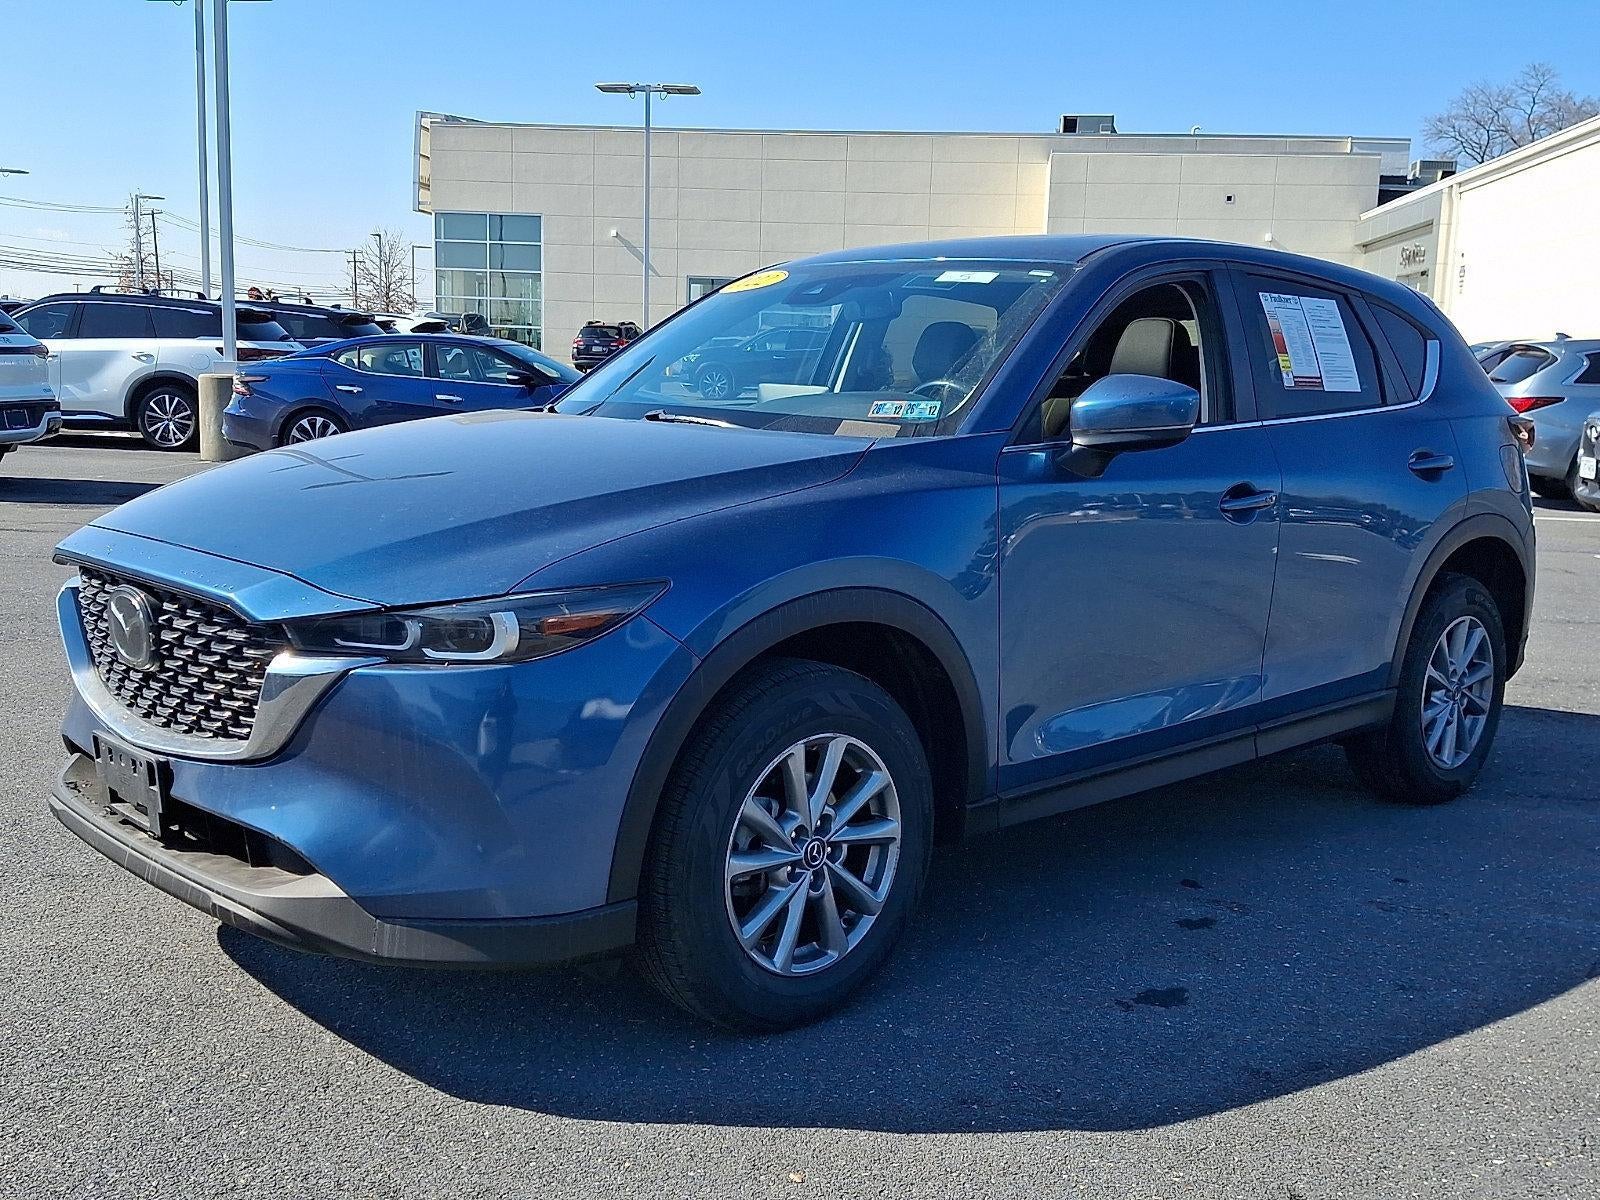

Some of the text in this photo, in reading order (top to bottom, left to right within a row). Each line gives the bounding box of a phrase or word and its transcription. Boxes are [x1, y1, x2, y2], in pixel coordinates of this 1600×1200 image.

[893, 404, 903, 415] 12
[905, 402, 917, 415] 26
[928, 405, 938, 416] 12
